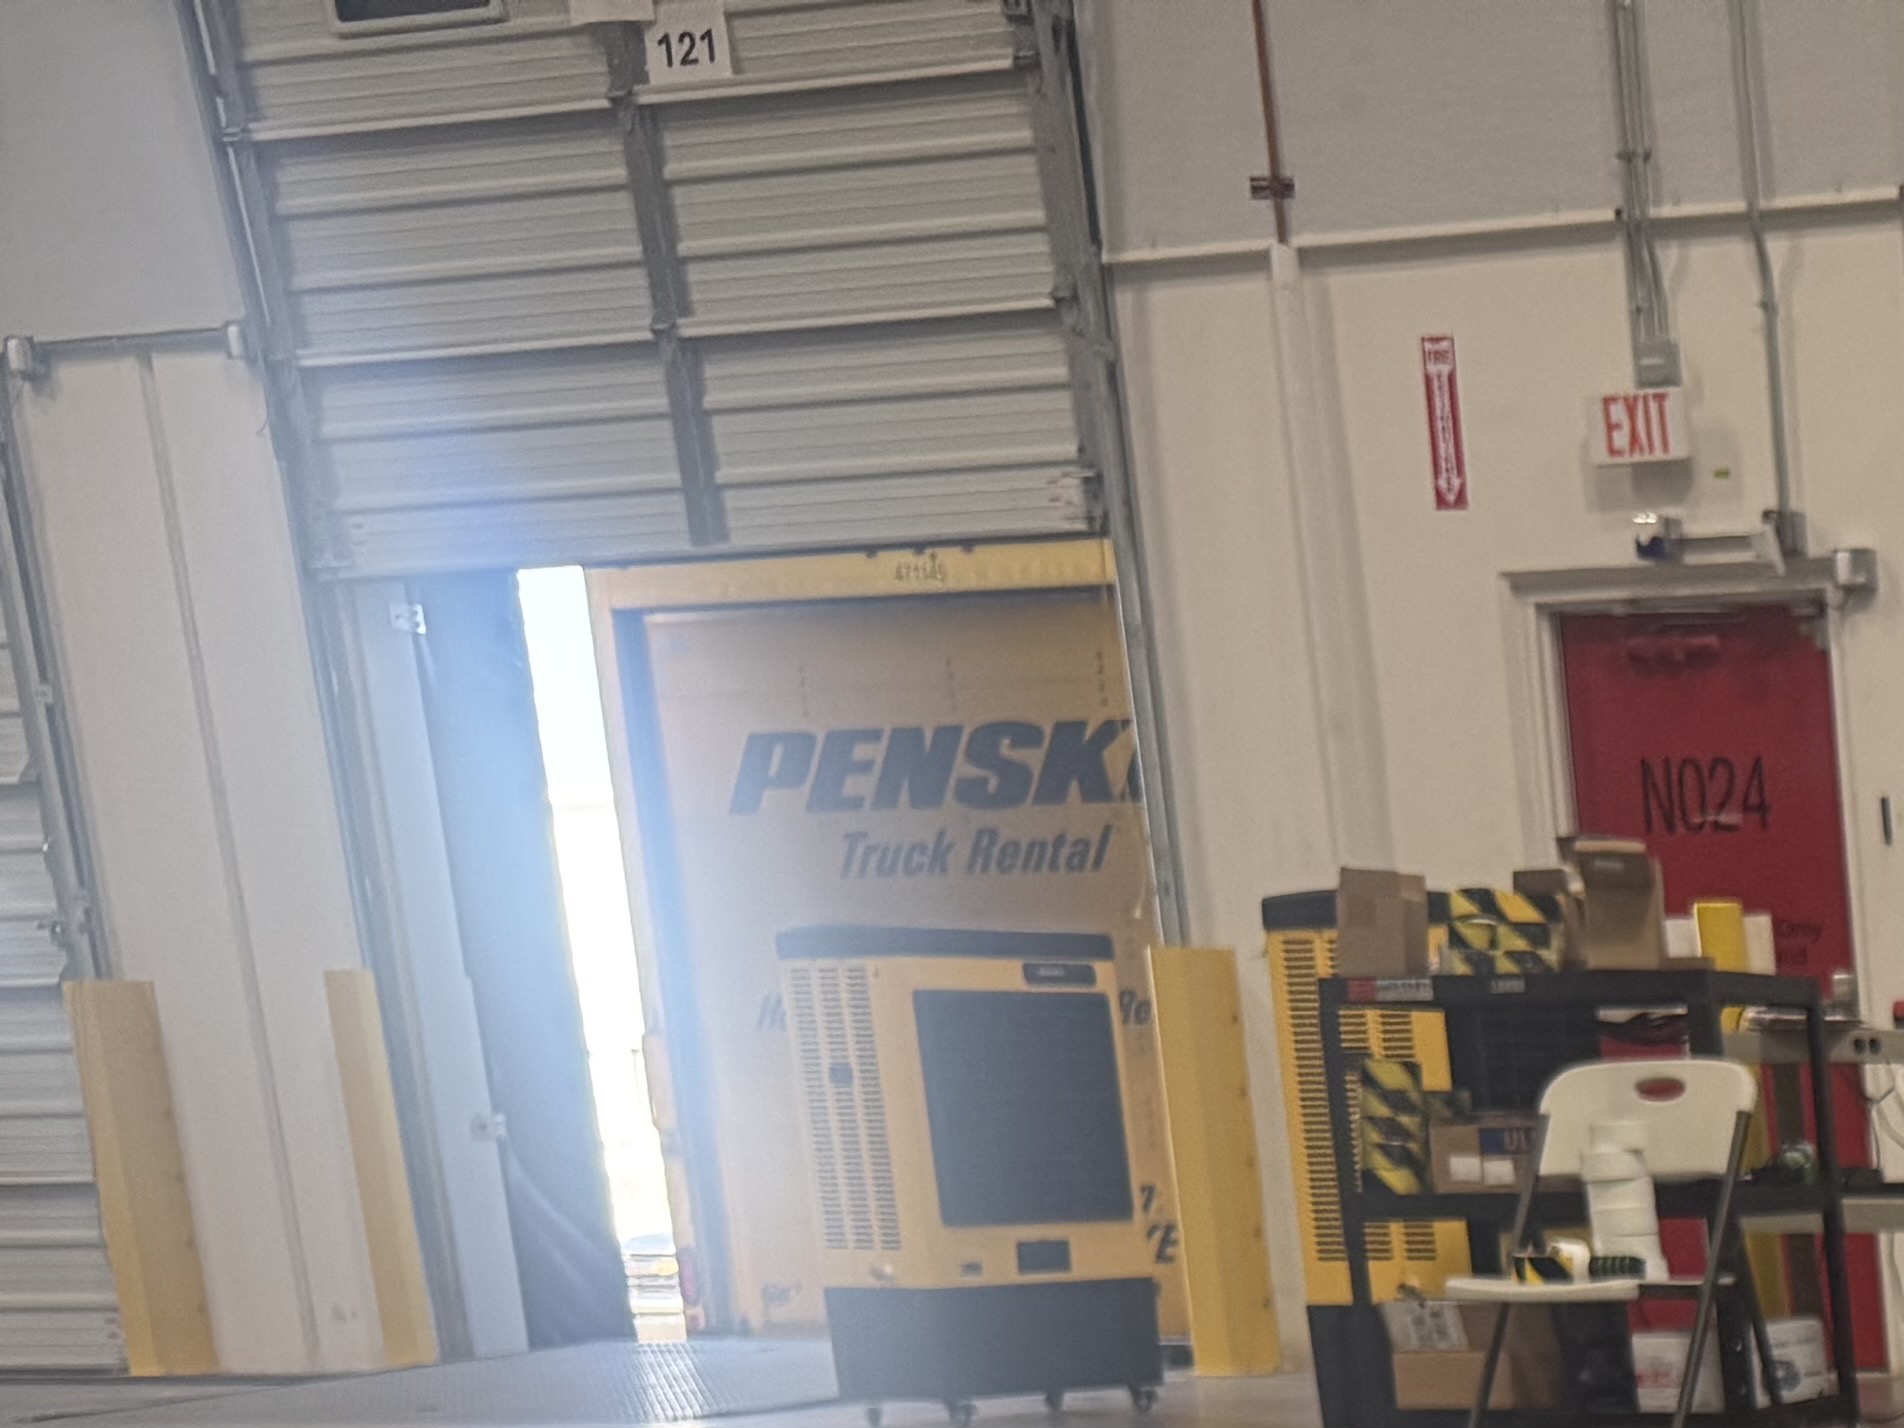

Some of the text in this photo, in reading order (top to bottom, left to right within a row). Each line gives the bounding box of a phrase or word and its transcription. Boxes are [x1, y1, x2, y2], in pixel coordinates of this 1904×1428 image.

[658, 29, 715, 67] 121
[1602, 392, 1669, 458] EXIT
[729, 719, 1142, 815] PENSK
[841, 824, 1113, 878] Truck Rental
